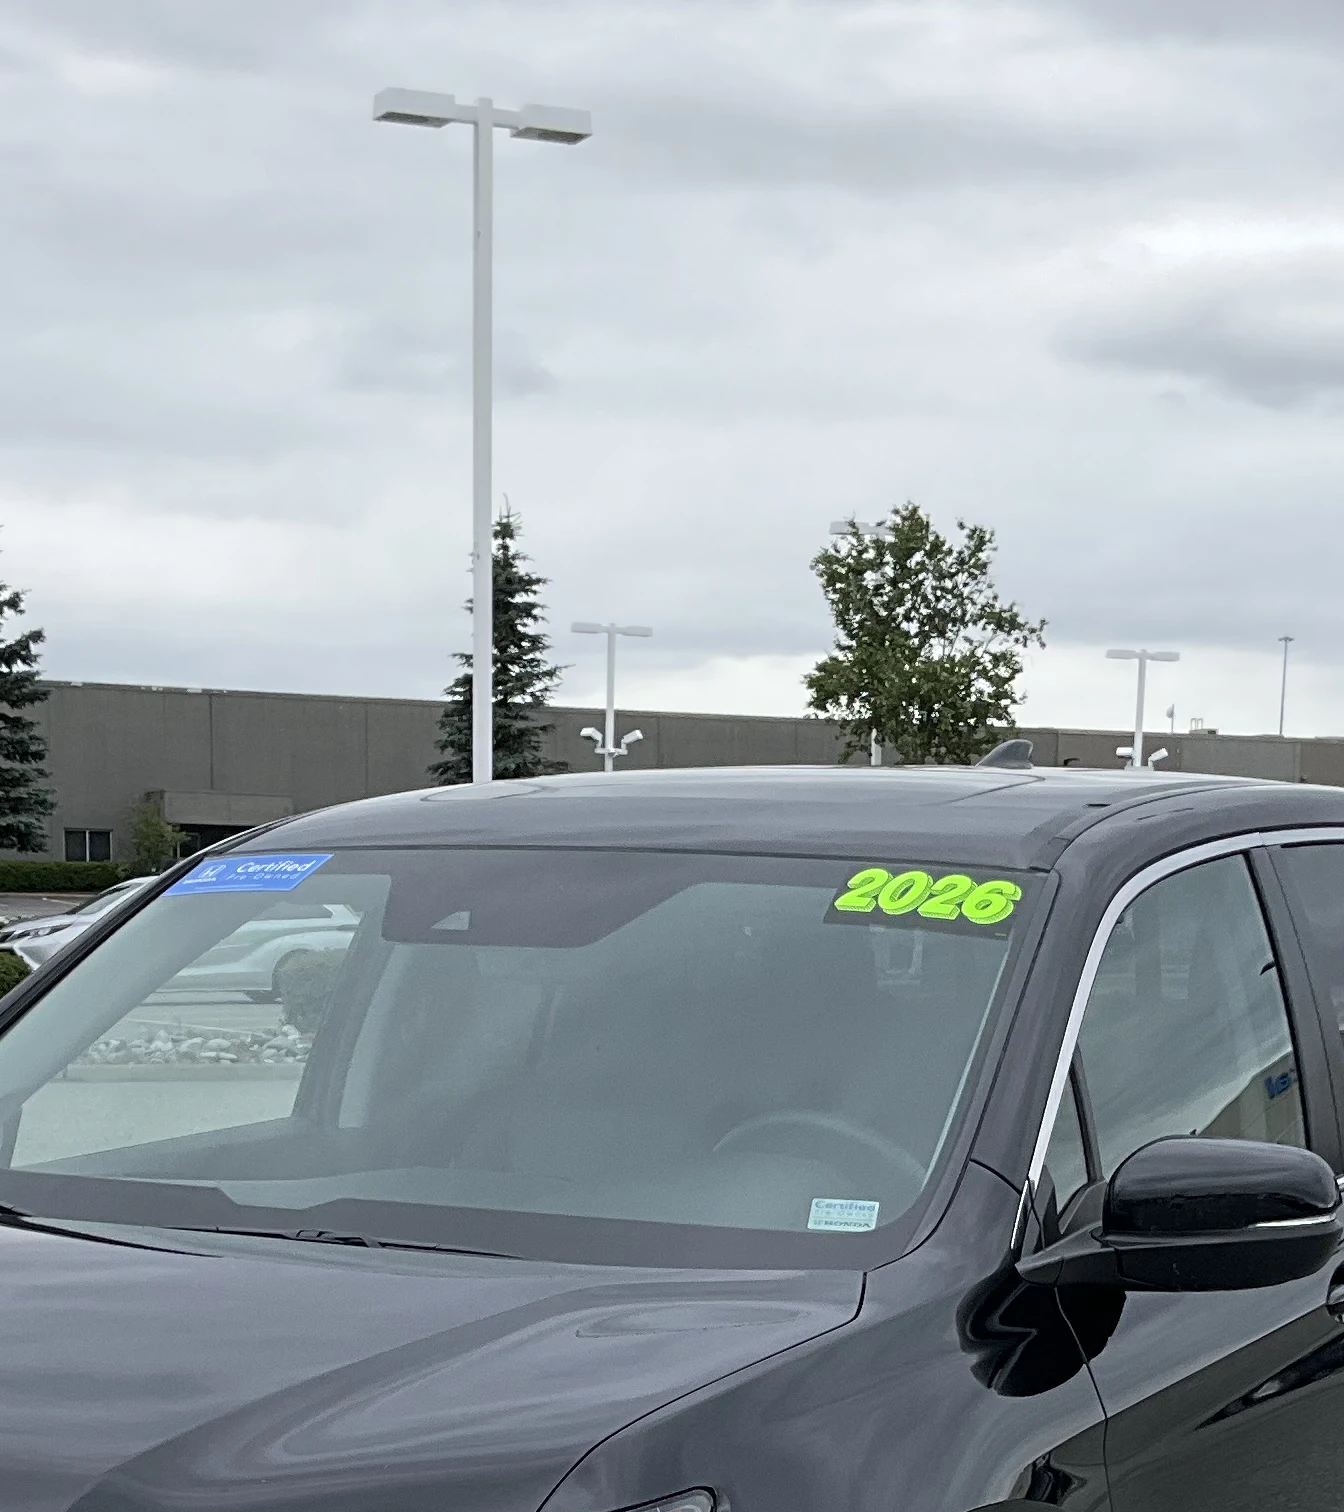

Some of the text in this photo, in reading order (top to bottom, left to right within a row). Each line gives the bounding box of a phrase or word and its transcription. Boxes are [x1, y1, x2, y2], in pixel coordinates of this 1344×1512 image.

[236, 860, 316, 873] Certified
[834, 868, 1022, 925] 2026
[815, 1200, 876, 1212] Certified
[824, 1220, 871, 1228] HONDA
